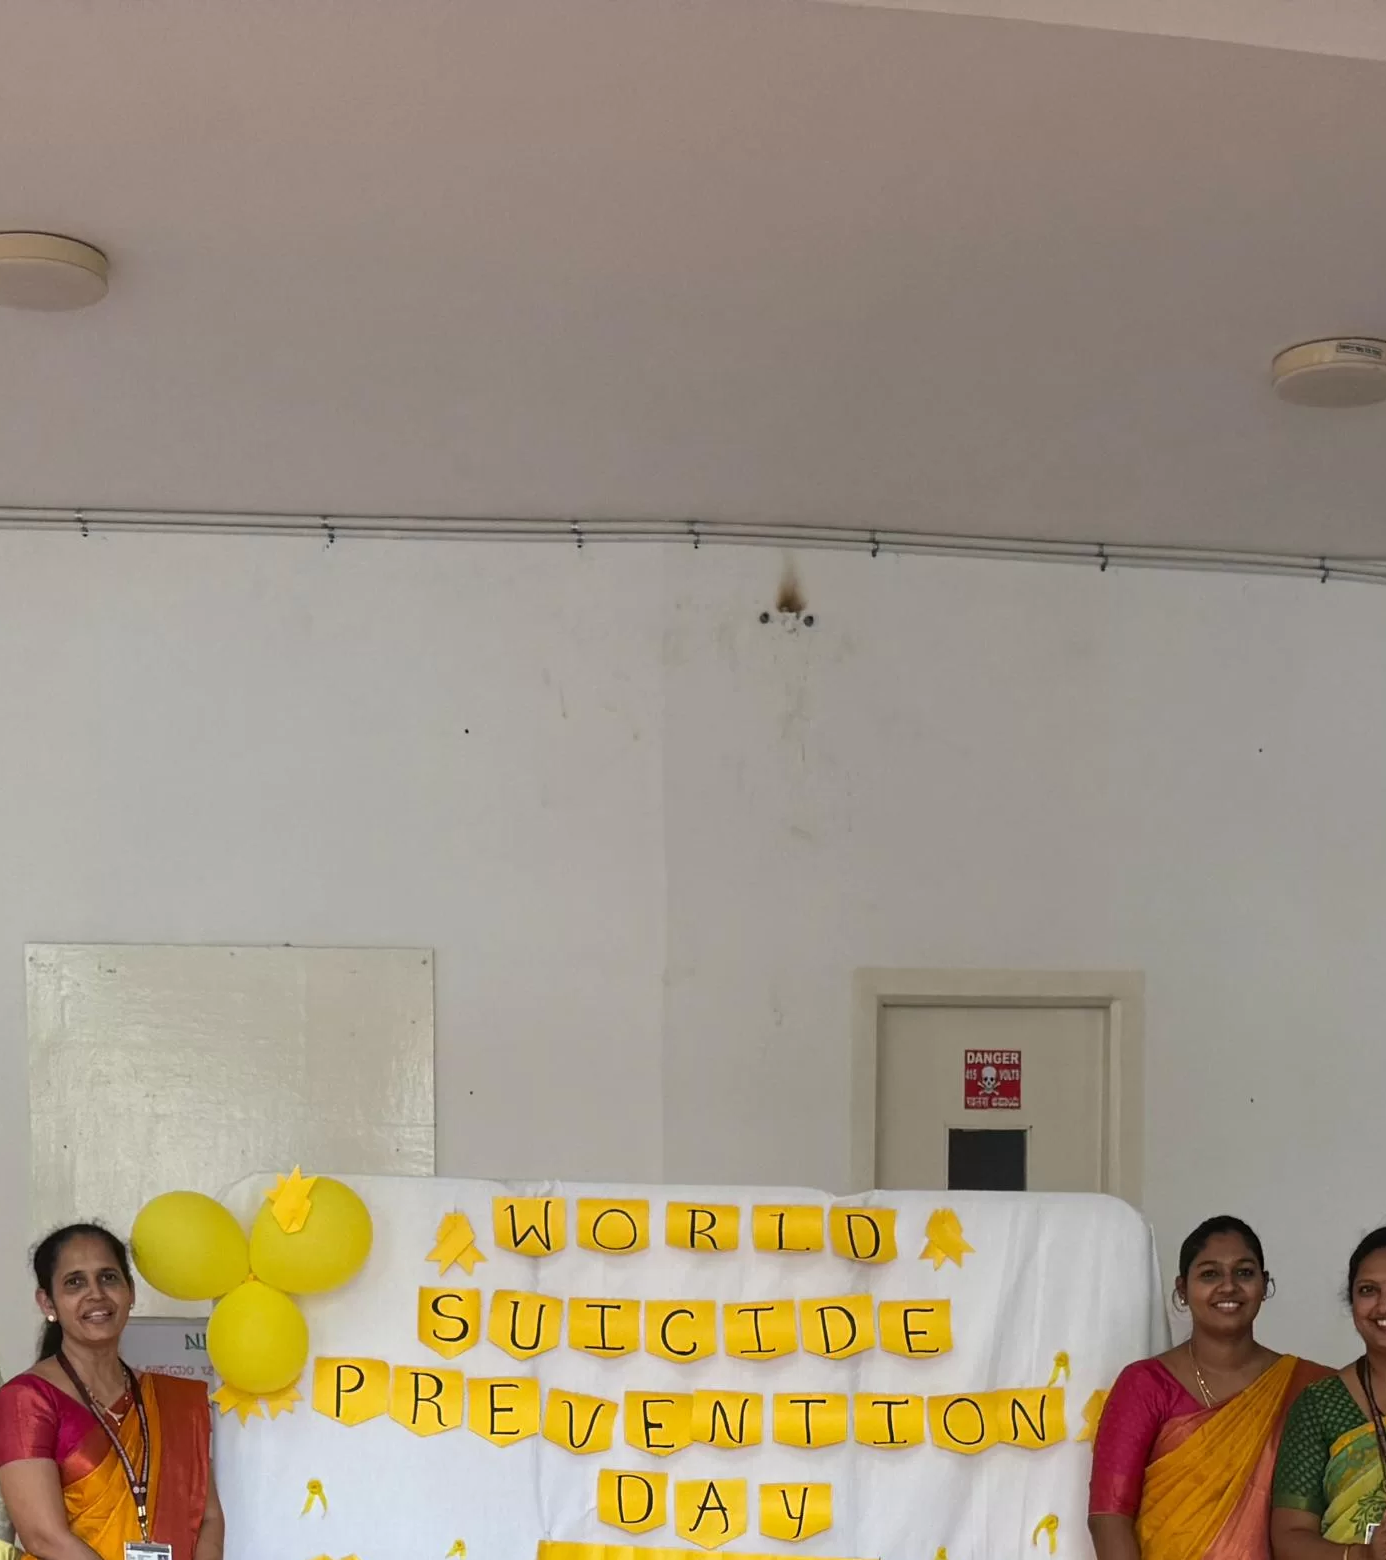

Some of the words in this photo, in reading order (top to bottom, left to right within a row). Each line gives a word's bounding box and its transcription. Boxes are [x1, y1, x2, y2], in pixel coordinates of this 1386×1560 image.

[967, 1051, 1019, 1065] DANGER
[999, 1069, 1020, 1081] VOLTS
[503, 1200, 881, 1260] WORLD
[430, 1293, 940, 1356] SUICIDE
[334, 1364, 1047, 1449] PREVENTION
[616, 1474, 808, 1538] DAY
